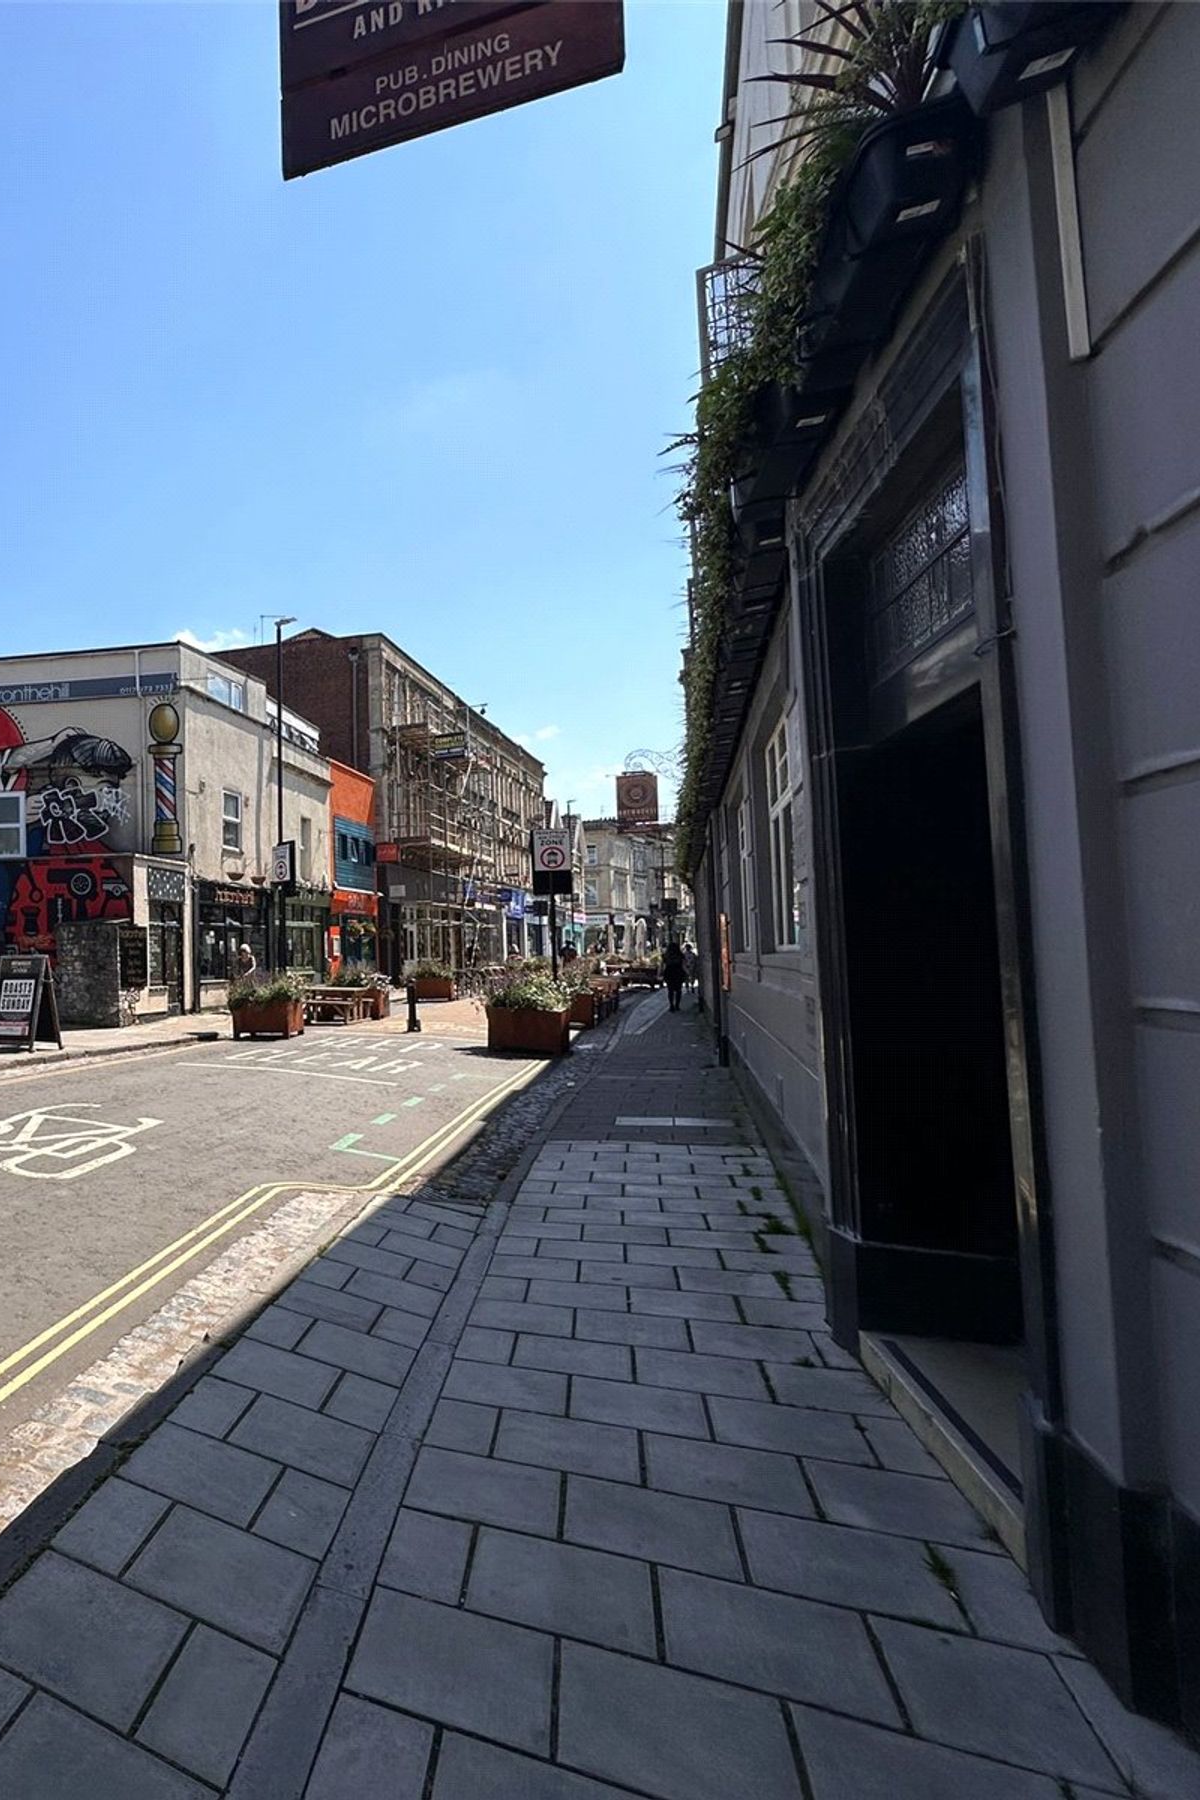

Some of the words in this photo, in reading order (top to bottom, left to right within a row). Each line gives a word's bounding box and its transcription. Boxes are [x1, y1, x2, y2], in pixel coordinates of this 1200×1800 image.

[352, 2, 403, 39] AND
[432, 33, 511, 75] DINING
[330, 40, 564, 141] MICROBREWERY
[3, 982, 33, 993] ROASTS
[1, 998, 31, 1010] SUNDAY
[301, 1036, 444, 1053] KEEP
[225, 1048, 425, 1075] CLEAR
